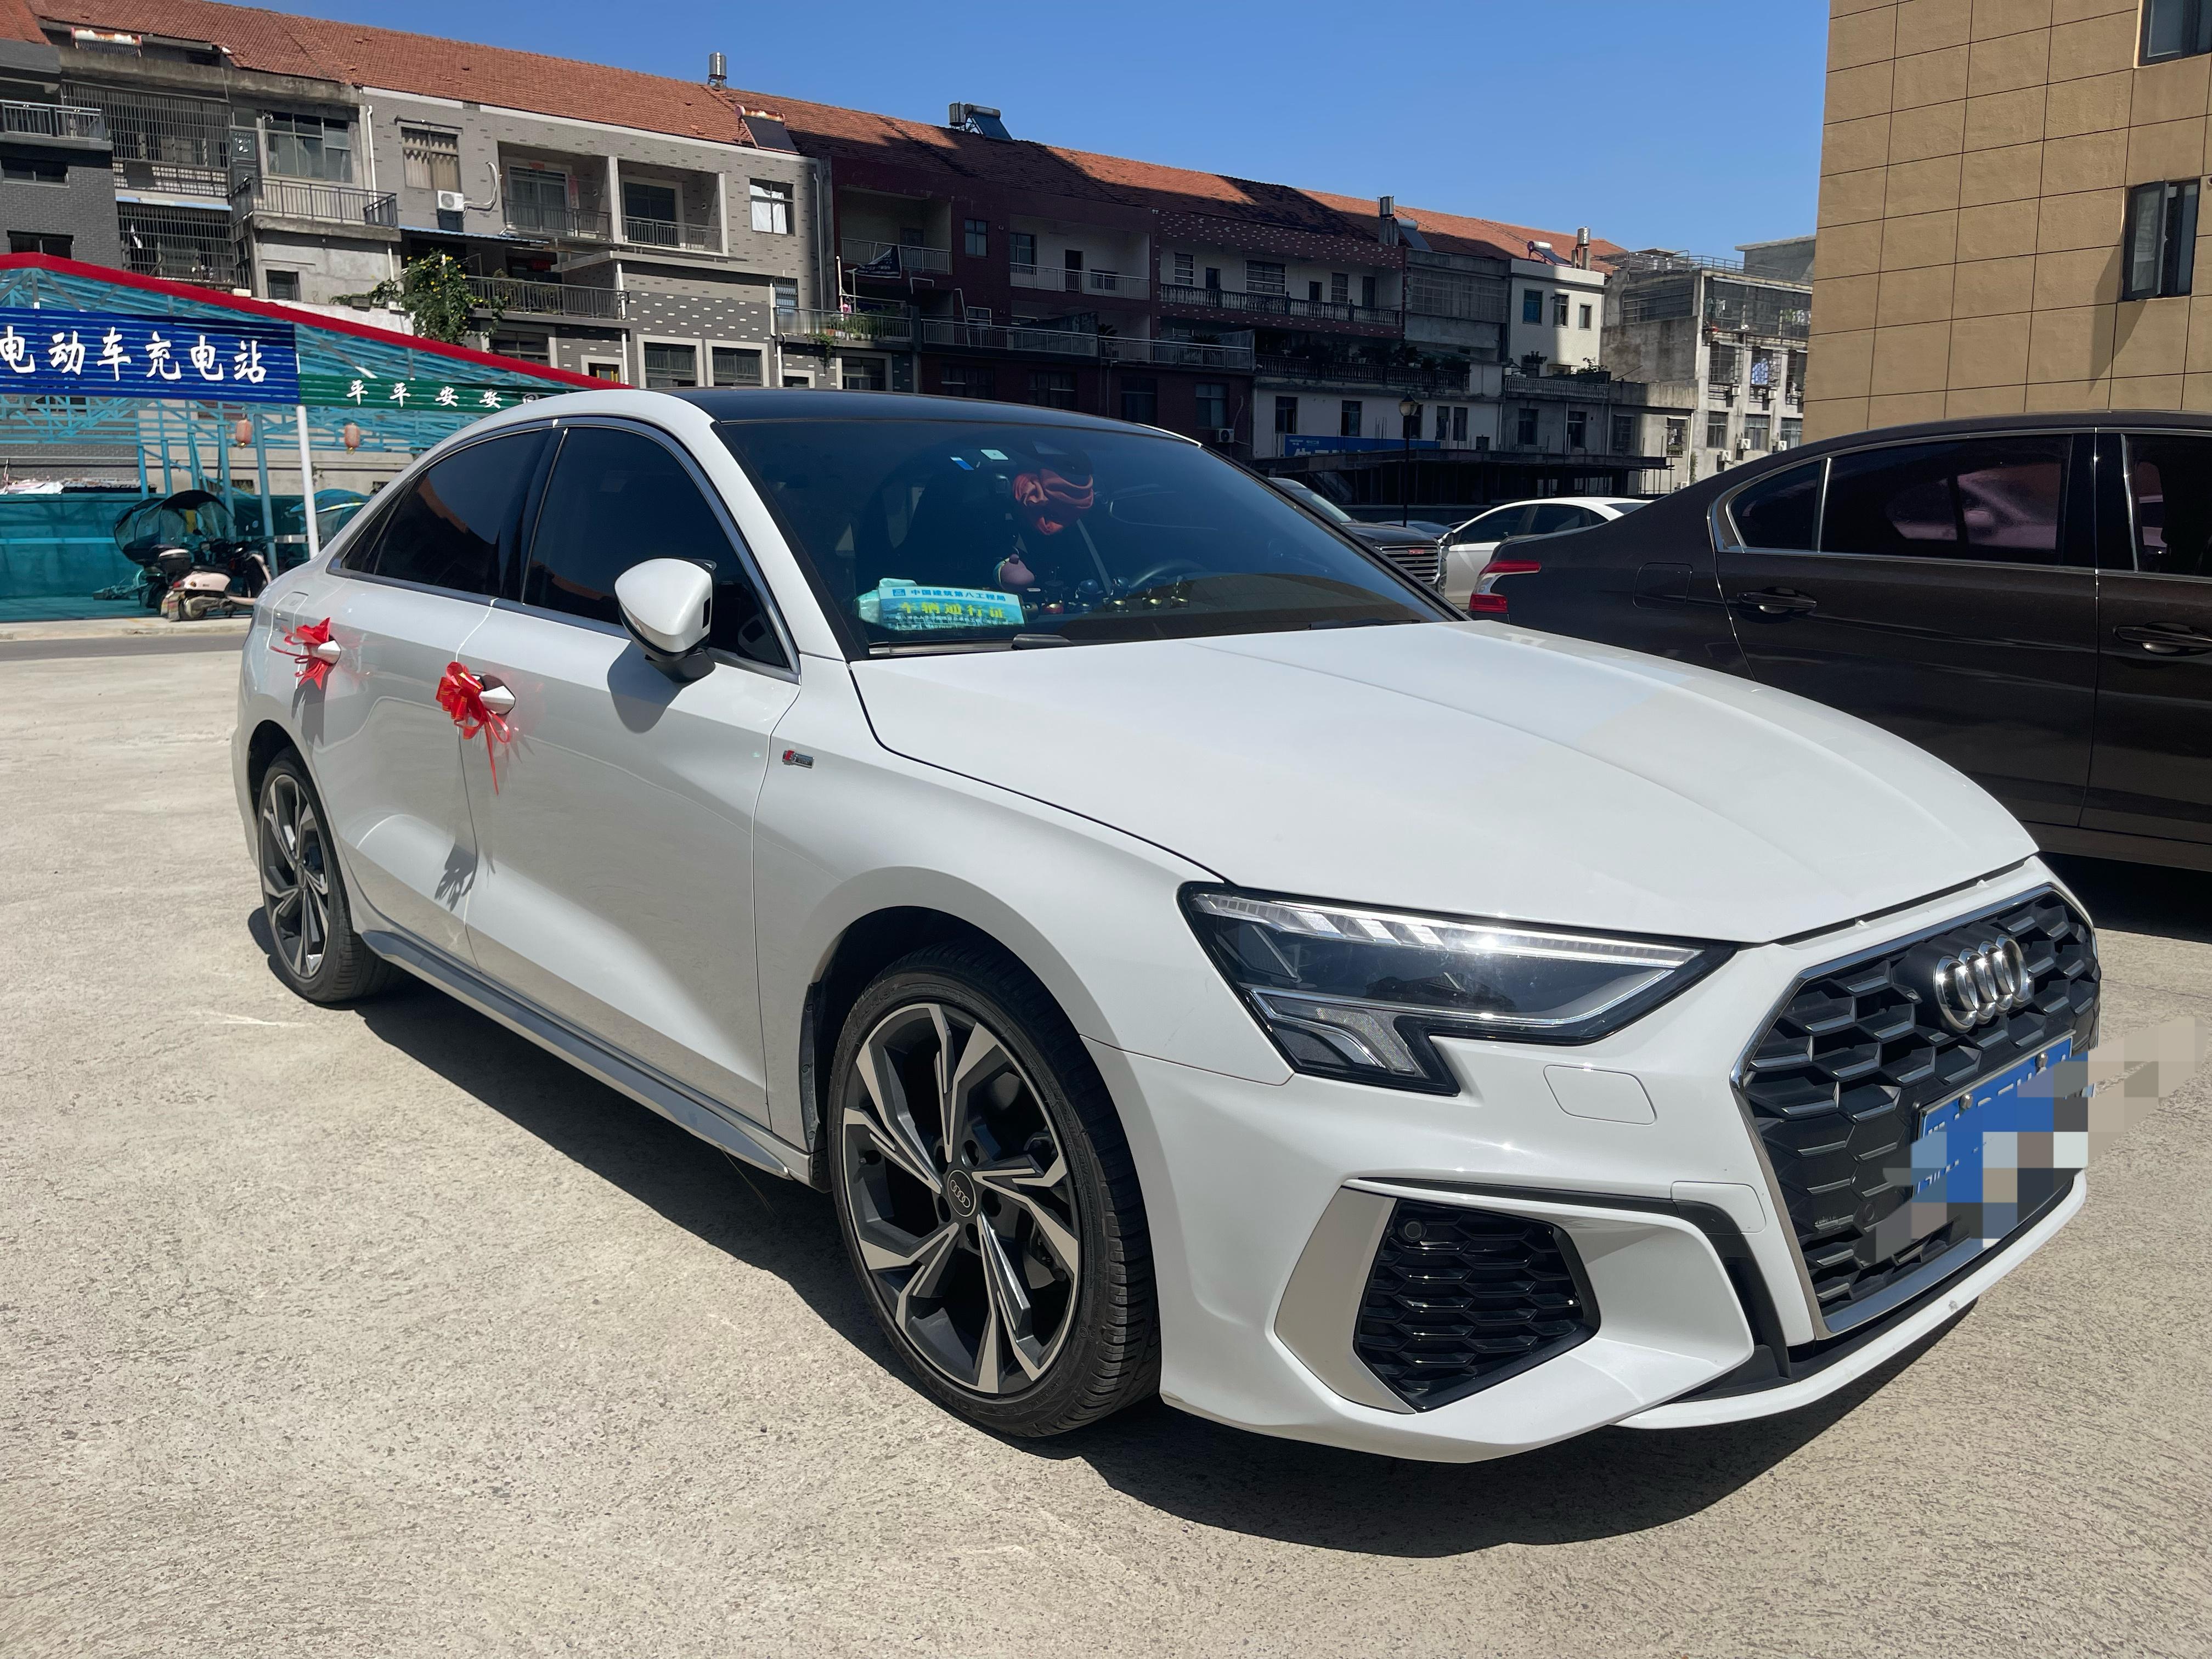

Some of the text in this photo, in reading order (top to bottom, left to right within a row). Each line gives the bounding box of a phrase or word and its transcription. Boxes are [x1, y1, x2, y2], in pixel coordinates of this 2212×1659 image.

[0, 325, 267, 384] 电动车充电站
[910, 589, 1006, 602] 中国建筑第八工程局
